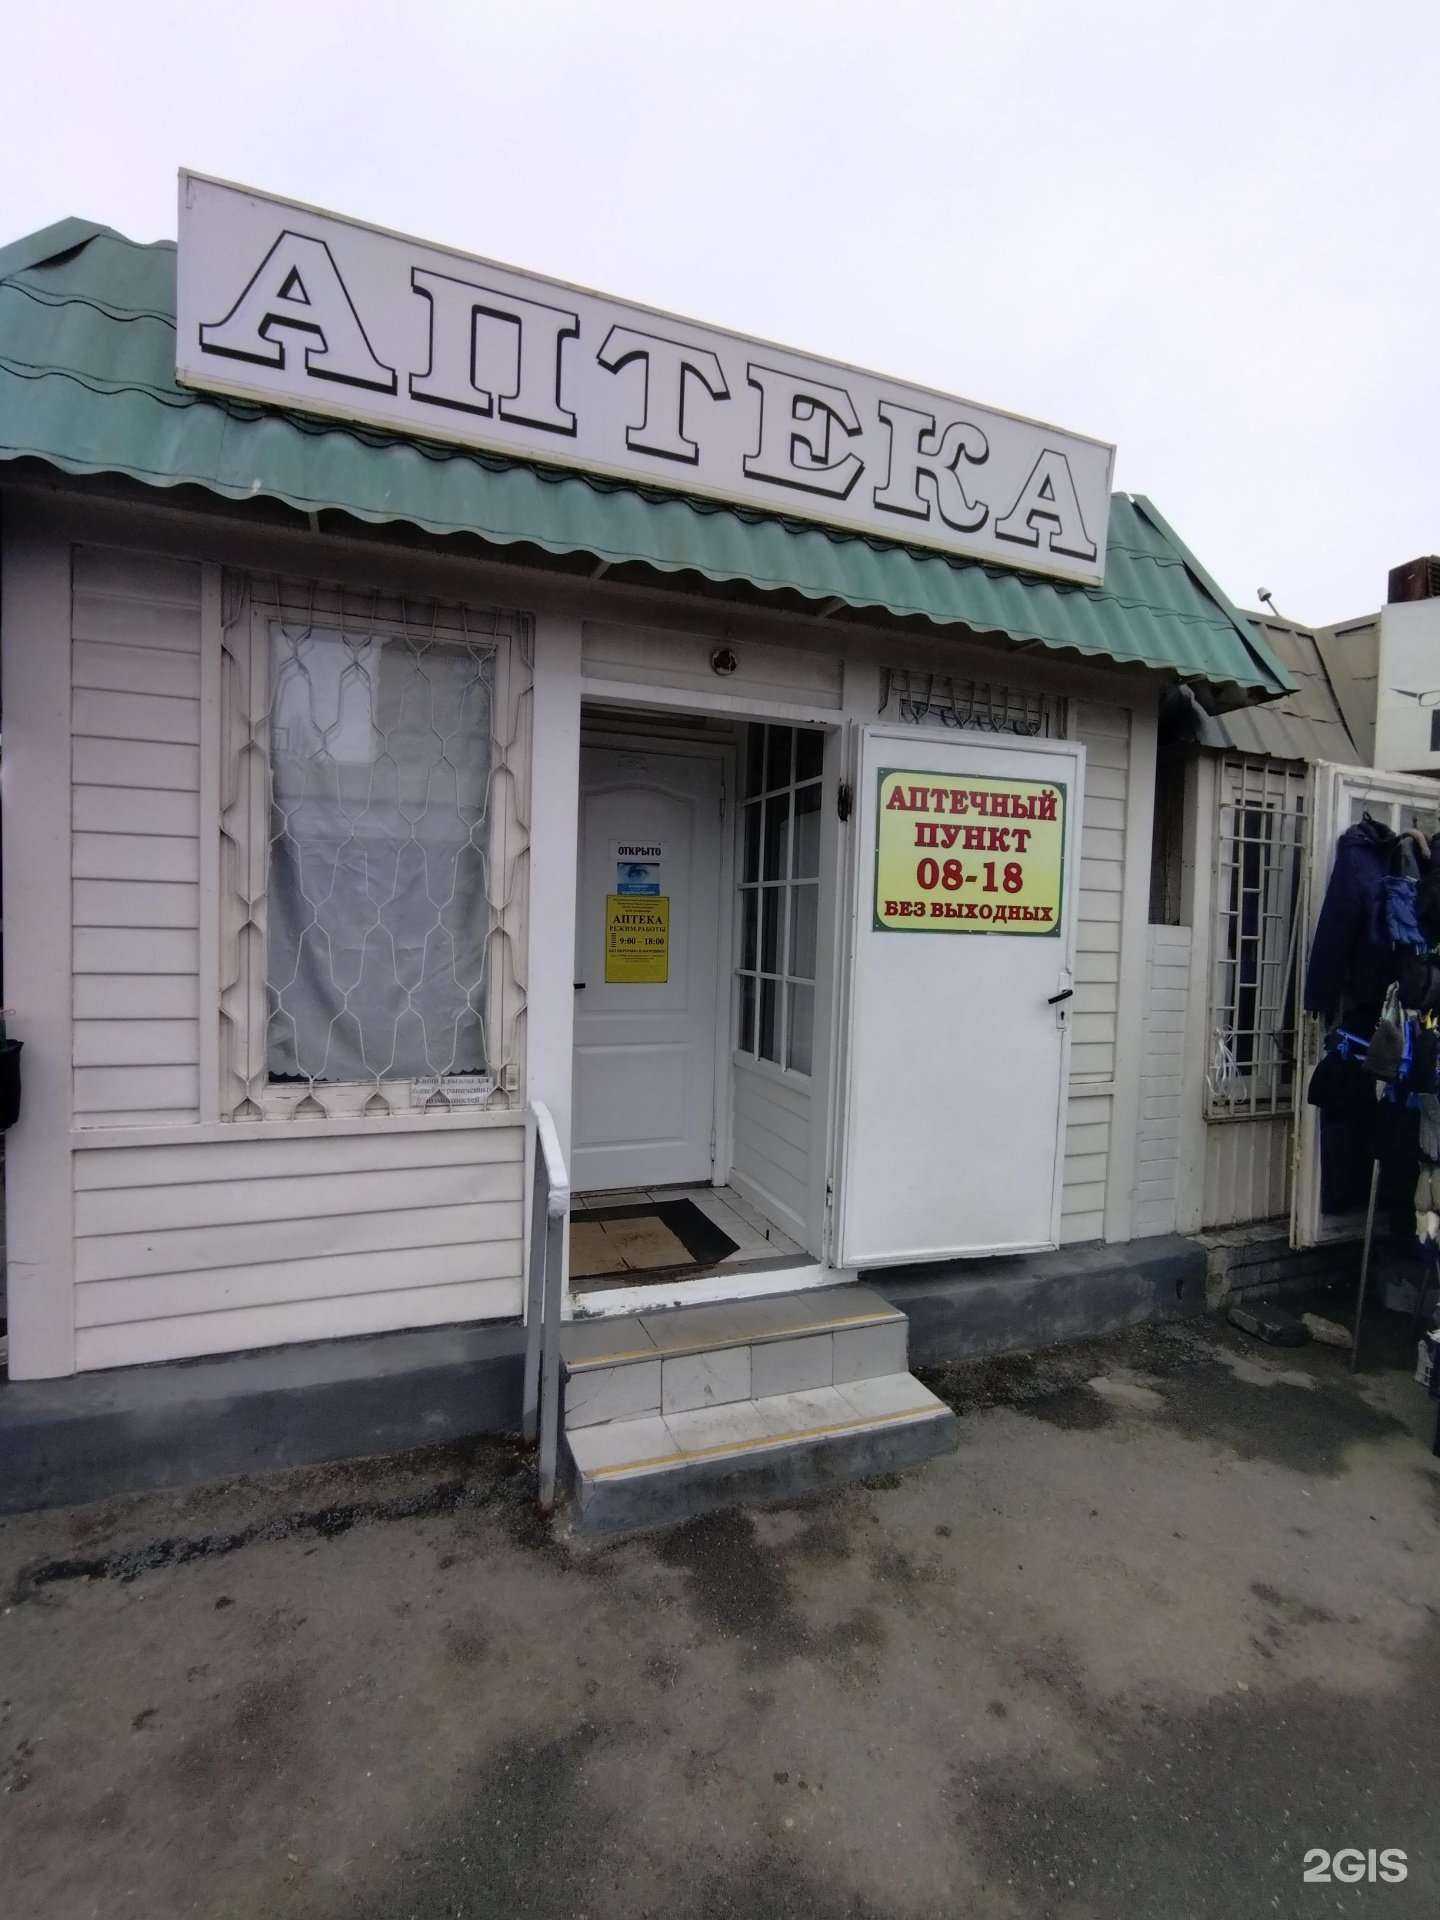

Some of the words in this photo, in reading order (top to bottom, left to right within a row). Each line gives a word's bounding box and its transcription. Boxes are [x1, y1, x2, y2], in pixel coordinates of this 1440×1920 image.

[198, 229, 1098, 562] АПТЕКА
[885, 785, 1058, 821] АПТЕЧНЫЙ
[617, 846, 662, 856] ОТКРЫТО
[914, 822, 1031, 853] ПУНКТ
[916, 857, 1023, 894] 08-18
[613, 914, 664, 925] АПТЕКА
[884, 901, 926, 917] БЕЗ
[930, 901, 1053, 924] ВЫХОДНЫХ
[619, 937, 636, 945] 9:00
[645, 937, 665, 945] 18:00
